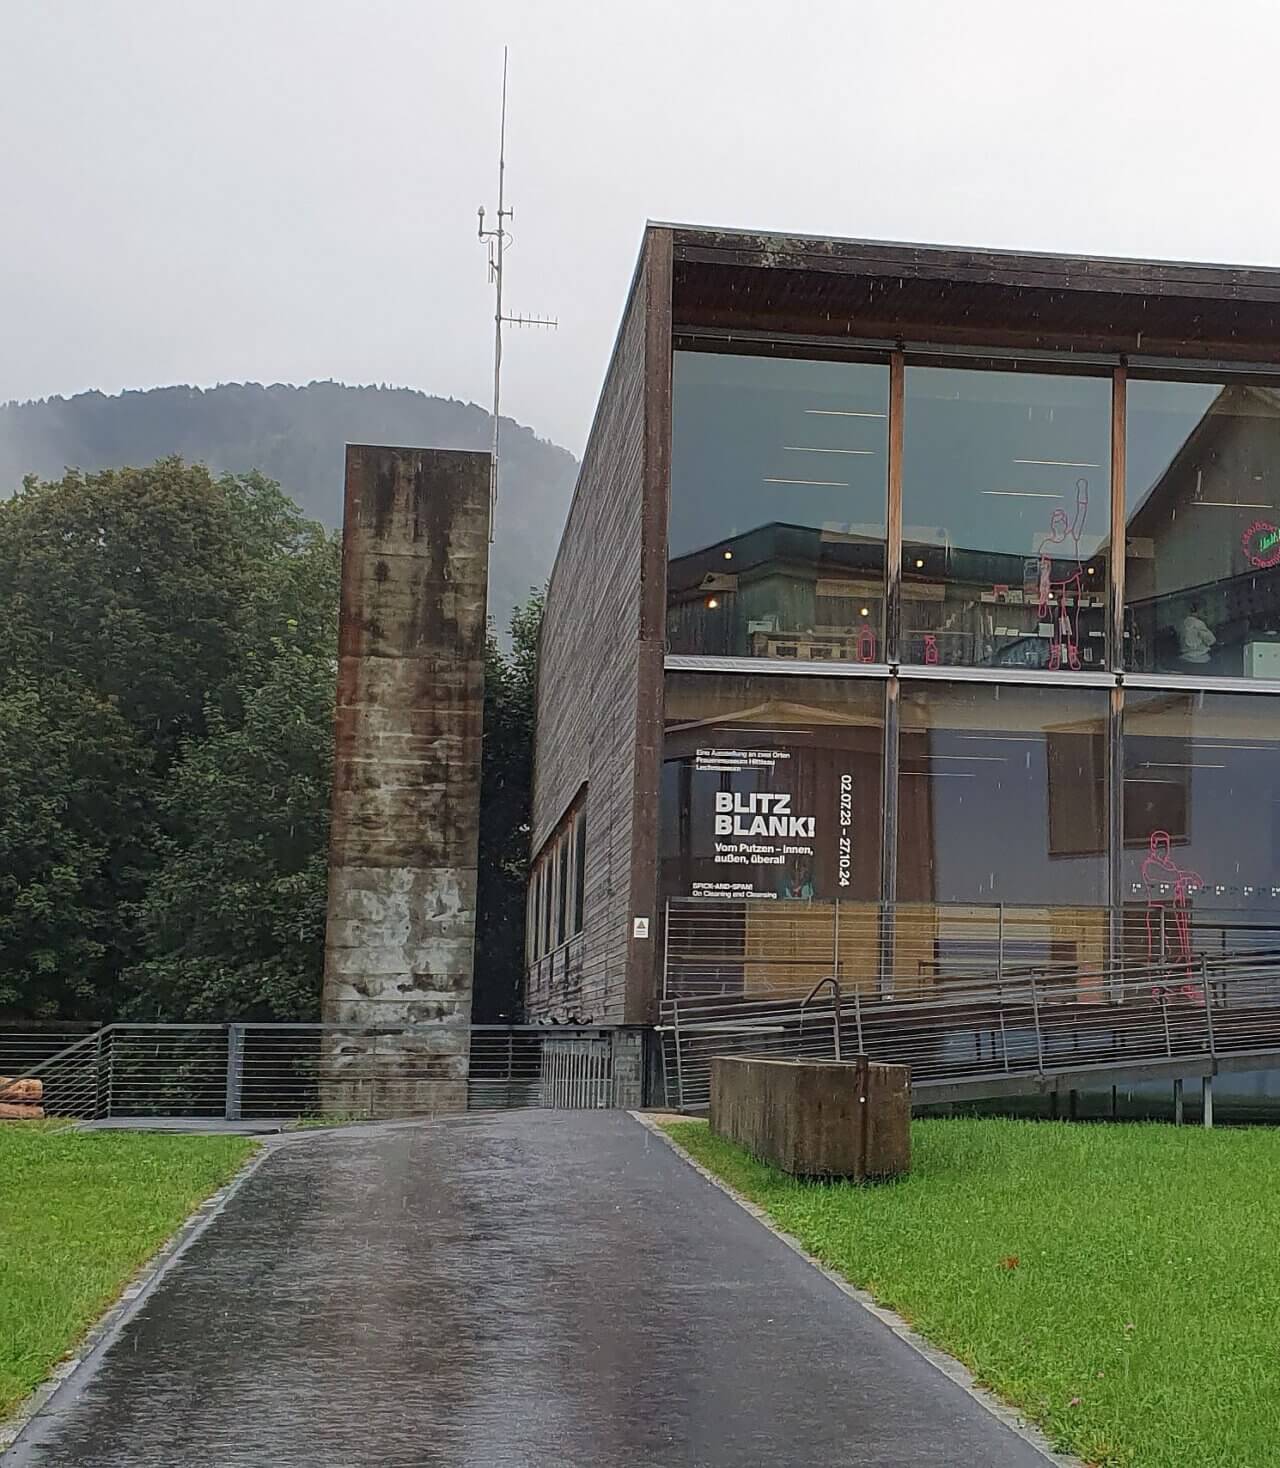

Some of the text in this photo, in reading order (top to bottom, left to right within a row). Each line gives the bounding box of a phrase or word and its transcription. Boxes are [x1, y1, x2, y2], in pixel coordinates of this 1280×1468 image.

[715, 792, 791, 814] BLITZ
[840, 774, 852, 826] 02.07.23
[714, 815, 816, 838] BLANK!
[714, 842, 738, 853] Vom
[739, 843, 775, 854] Putzen
[783, 845, 814, 856] innen,
[714, 854, 785, 864] außen, überall
[839, 838, 851, 887] 27.10.24
